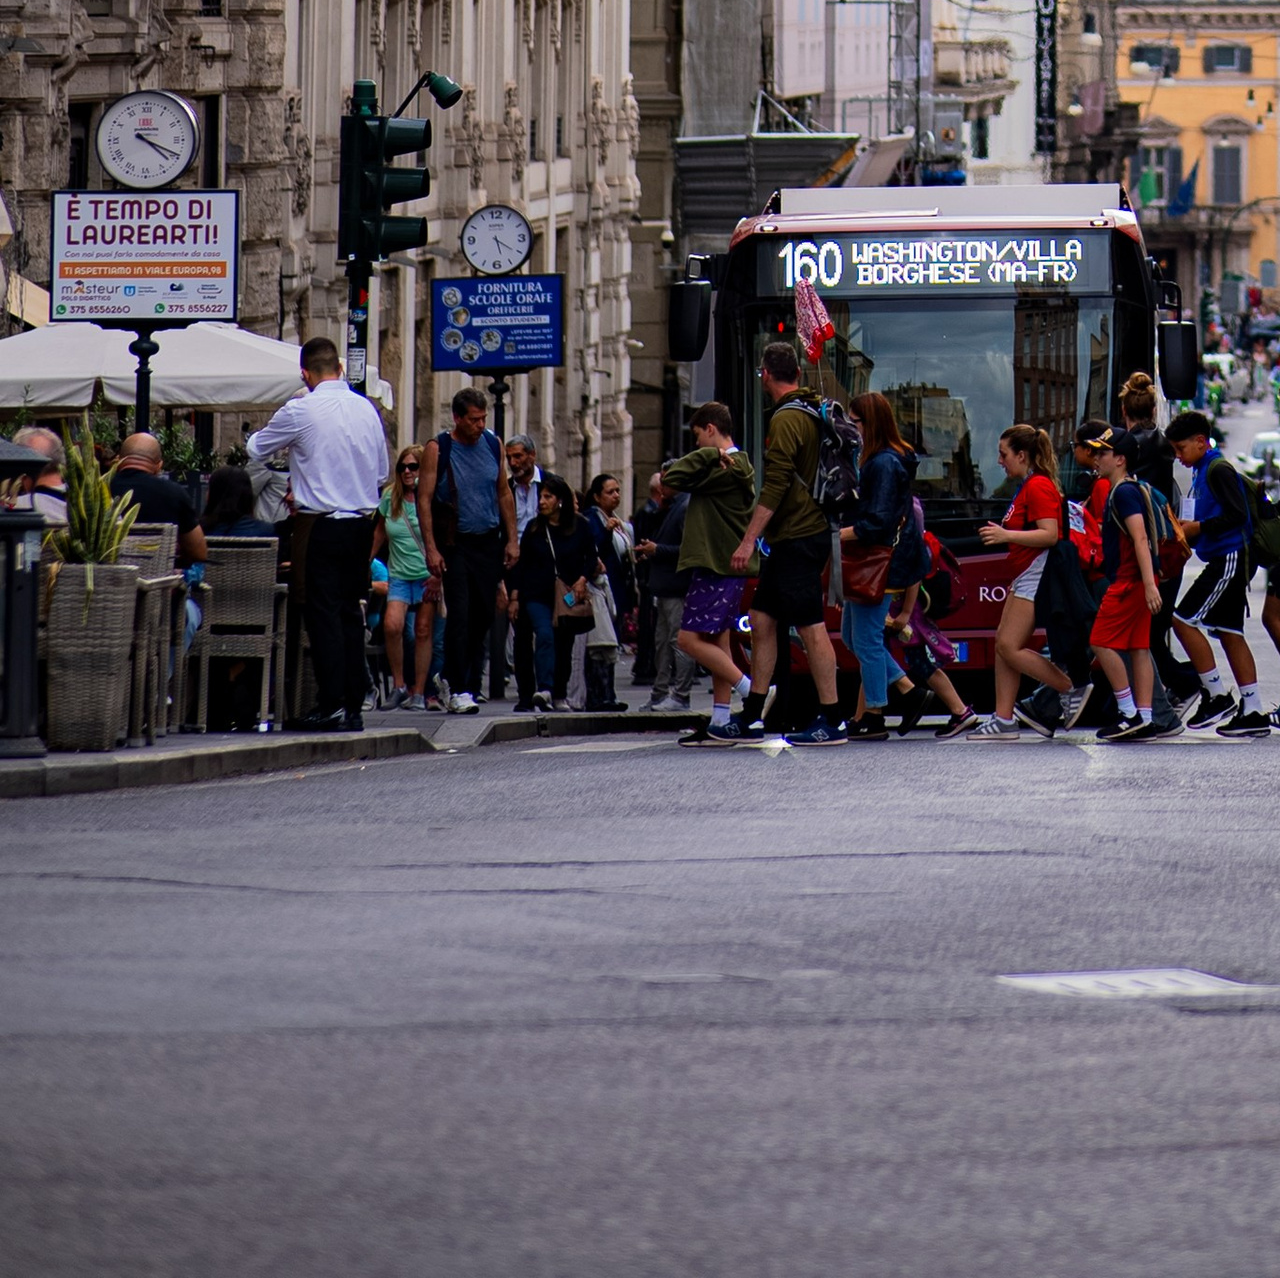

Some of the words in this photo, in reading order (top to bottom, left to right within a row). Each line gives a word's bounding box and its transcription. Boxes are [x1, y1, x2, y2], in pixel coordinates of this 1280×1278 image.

[88, 199, 179, 220] TEMPO
[188, 199, 212, 220] DI
[489, 210, 503, 220] 12
[66, 224, 218, 245] LAUREARTI!
[517, 233, 526, 243] 3
[467, 235, 476, 245] 9
[95, 251, 112, 259] puoi
[135, 250, 189, 258] comodamente
[492, 260, 502, 270] 6
[778, 241, 843, 288] 160
[852, 240, 1082, 264] WASHINGTON/VILLA
[64, 266, 73, 275] TI
[74, 266, 132, 275] ASPETTIAMO
[133, 266, 143, 275] IN
[145, 266, 171, 275] VIALE
[857, 263, 981, 285] BORGHESE
[987, 261, 1078, 283] (MA-FR)
[477, 282, 543, 294] FORNITURA
[468, 294, 512, 306] SCUOLE
[516, 292, 553, 304] ORAFE
[69, 305, 86, 314] 375
[88, 305, 131, 314] 8556260
[168, 304, 185, 313] 375
[187, 304, 228, 313] 8556227
[487, 305, 534, 315] OREFICERIE
[979, 586, 1008, 602] RO
